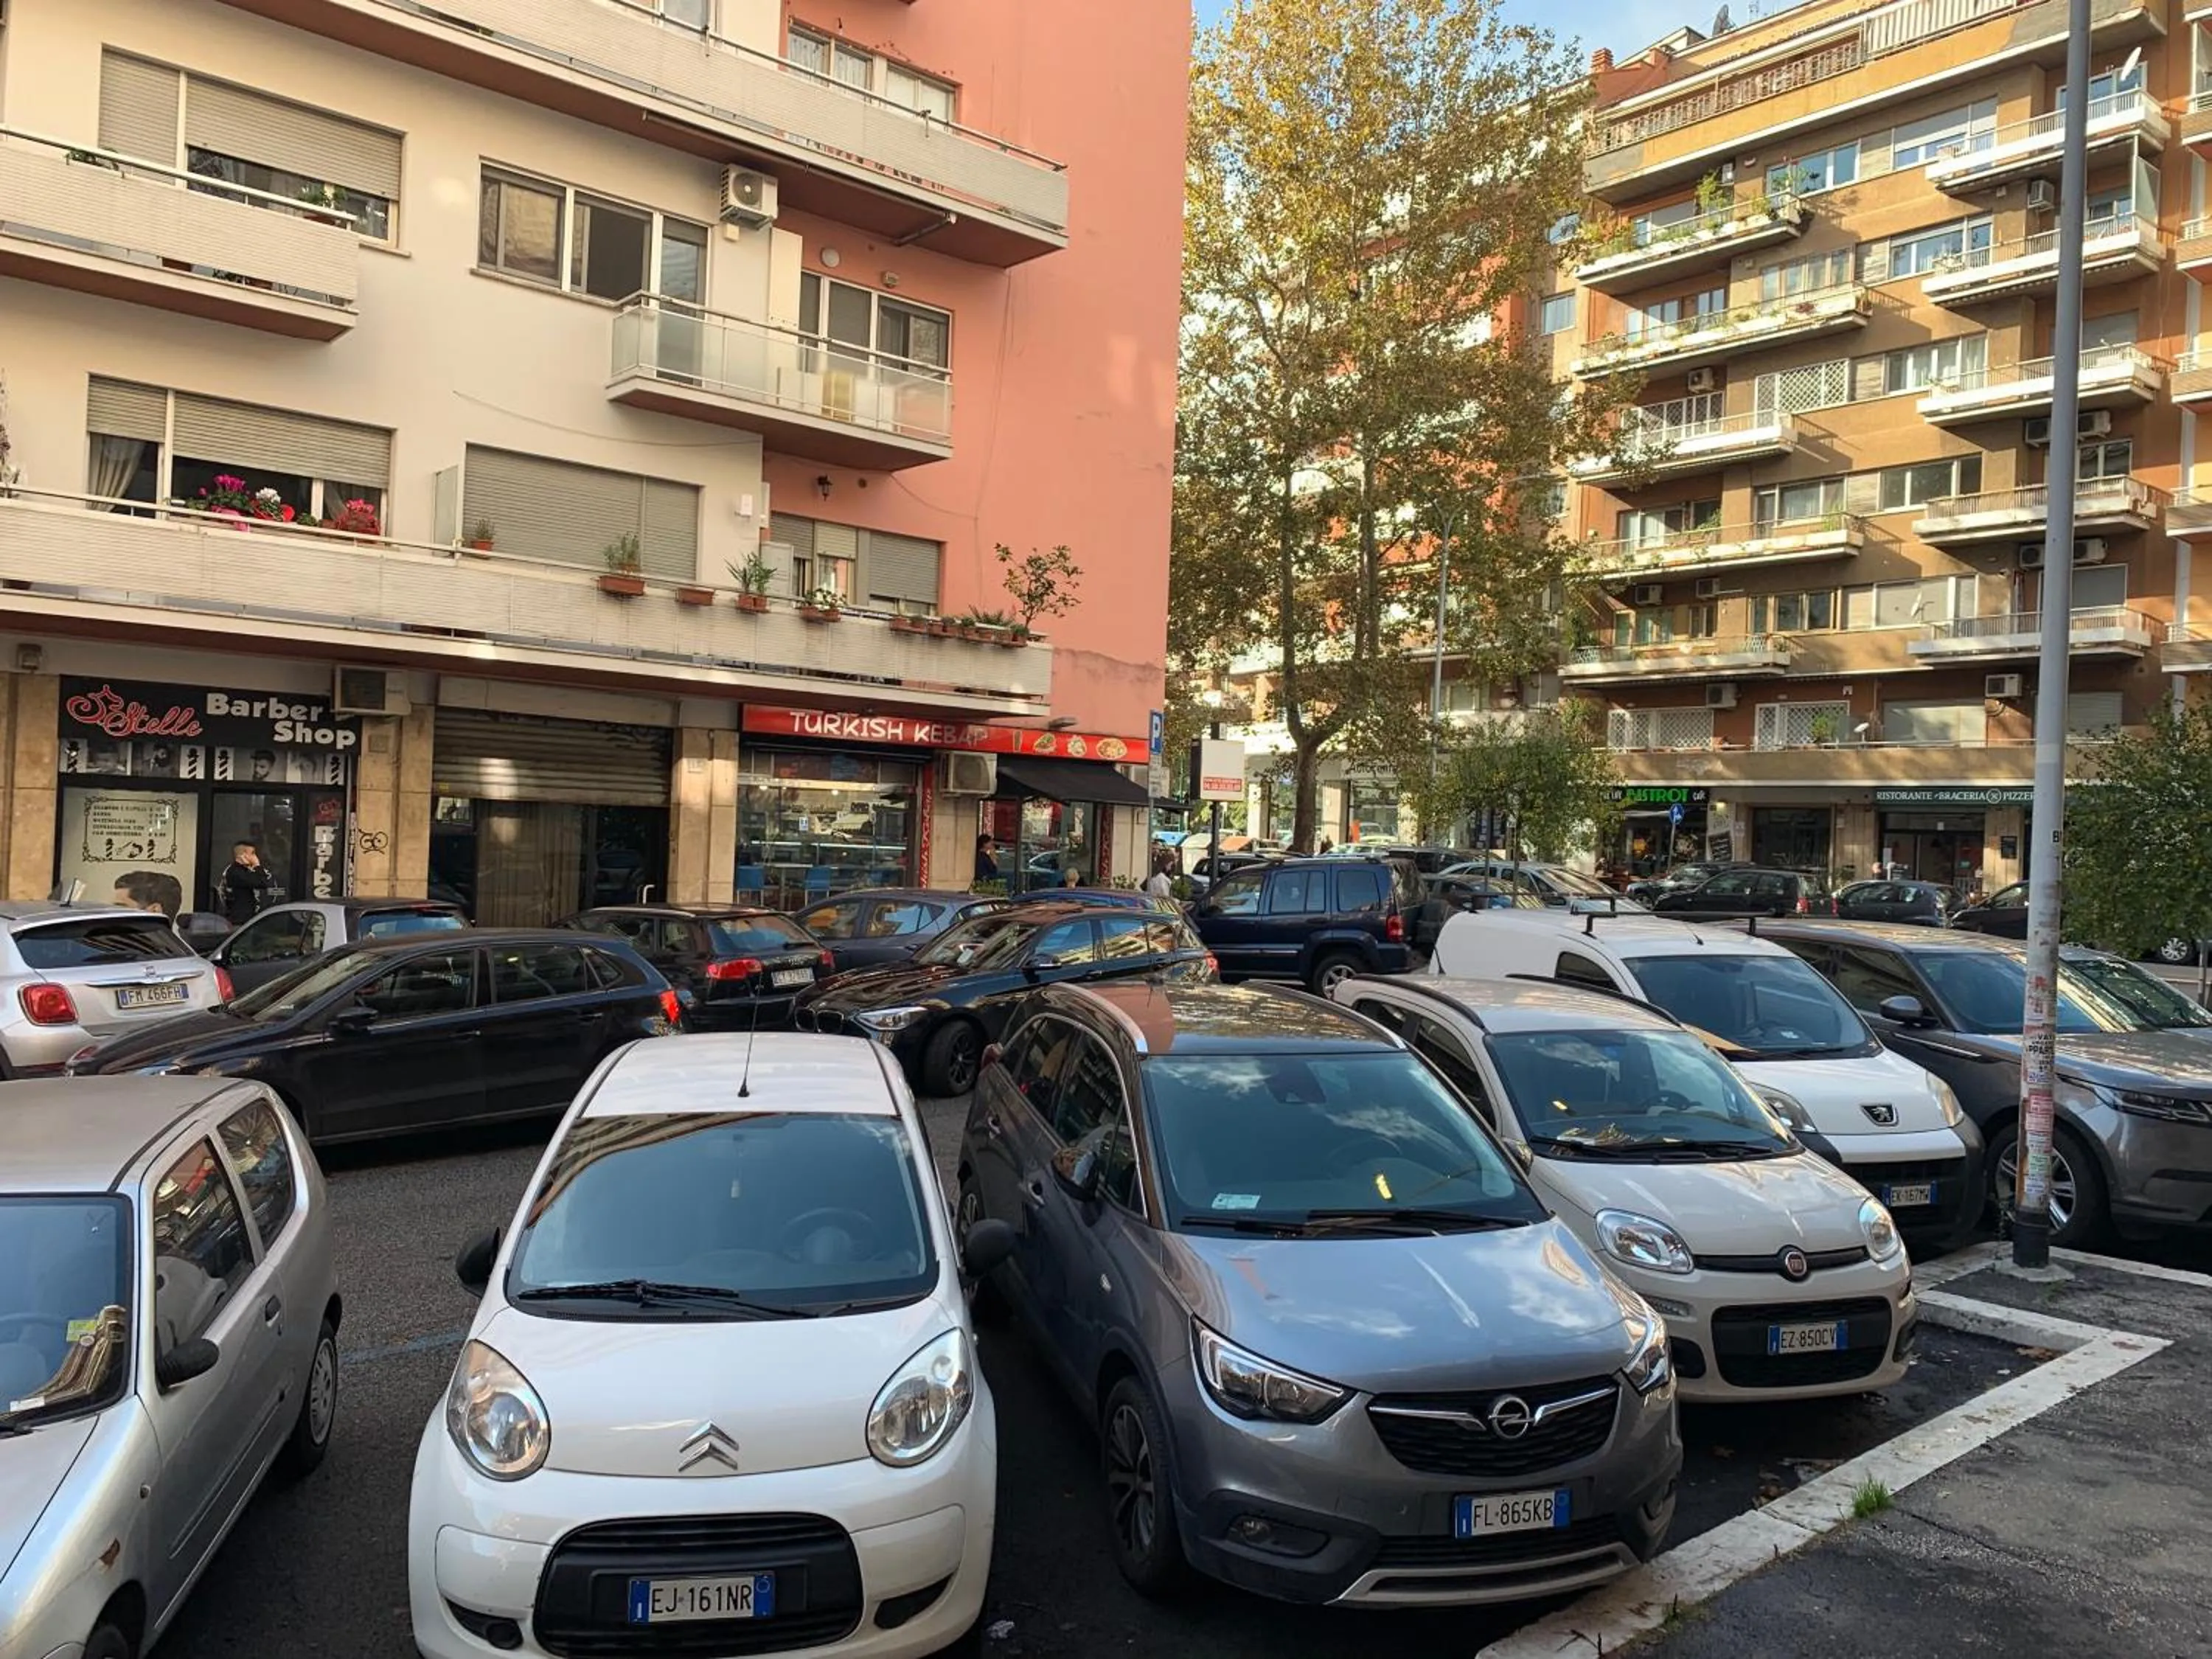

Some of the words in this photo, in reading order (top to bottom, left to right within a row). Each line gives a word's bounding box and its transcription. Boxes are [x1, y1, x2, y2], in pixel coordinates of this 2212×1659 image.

[206, 692, 323, 721] Barber
[273, 720, 356, 750] Shop
[790, 712, 903, 741] TURKISH
[1152, 714, 1161, 749] P
[1877, 791, 1933, 800] RISTORANTE
[1938, 791, 1986, 800] BRACERIA
[313, 825, 335, 898] Barbe
[1781, 1331, 1796, 1349] EZ
[1800, 1328, 1835, 1347] 850CV
[1474, 1505, 1494, 1528] FL
[1500, 1498, 1554, 1526] 865KB
[651, 1587, 678, 1614] EJ
[688, 1585, 751, 1613] 161NR
